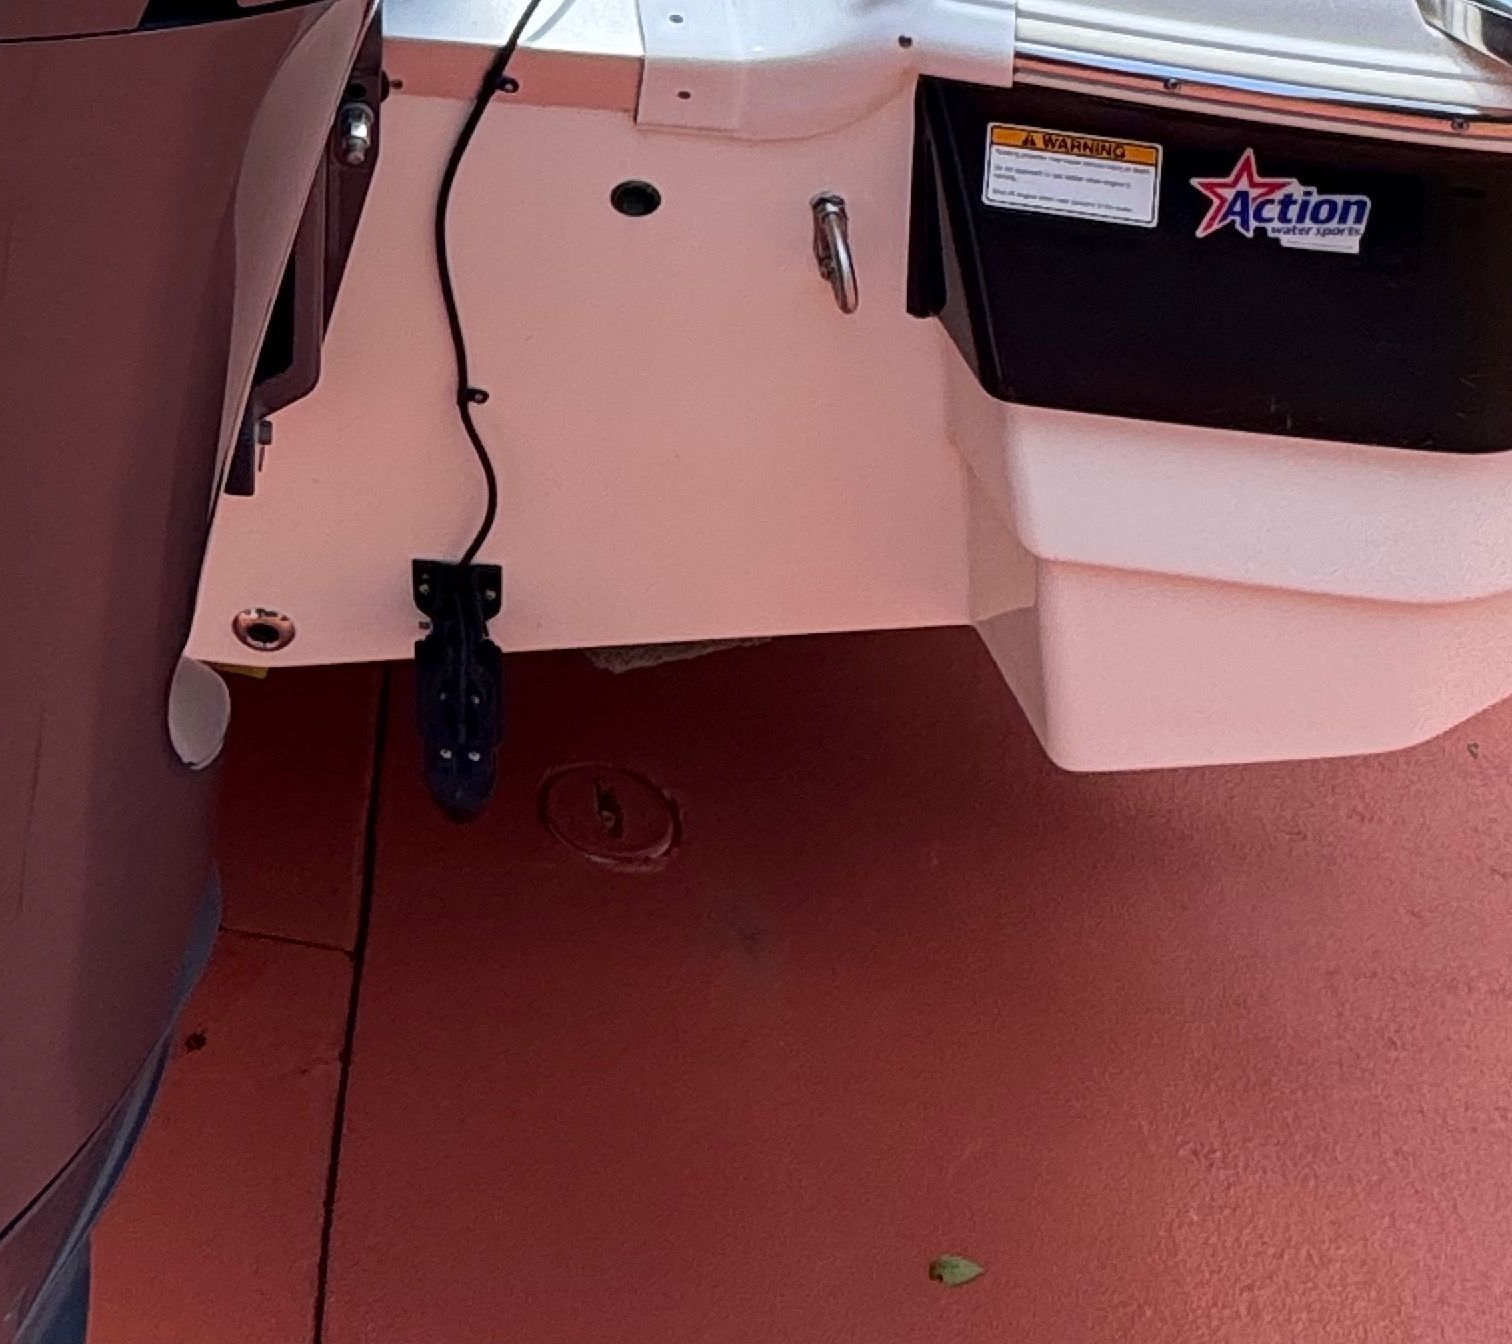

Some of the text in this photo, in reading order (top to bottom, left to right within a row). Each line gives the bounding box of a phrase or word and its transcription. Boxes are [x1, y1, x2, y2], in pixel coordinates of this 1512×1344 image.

[1042, 133, 1127, 160] WARNING
[1216, 190, 1369, 233] Action
[1270, 226, 1363, 238] water sports
